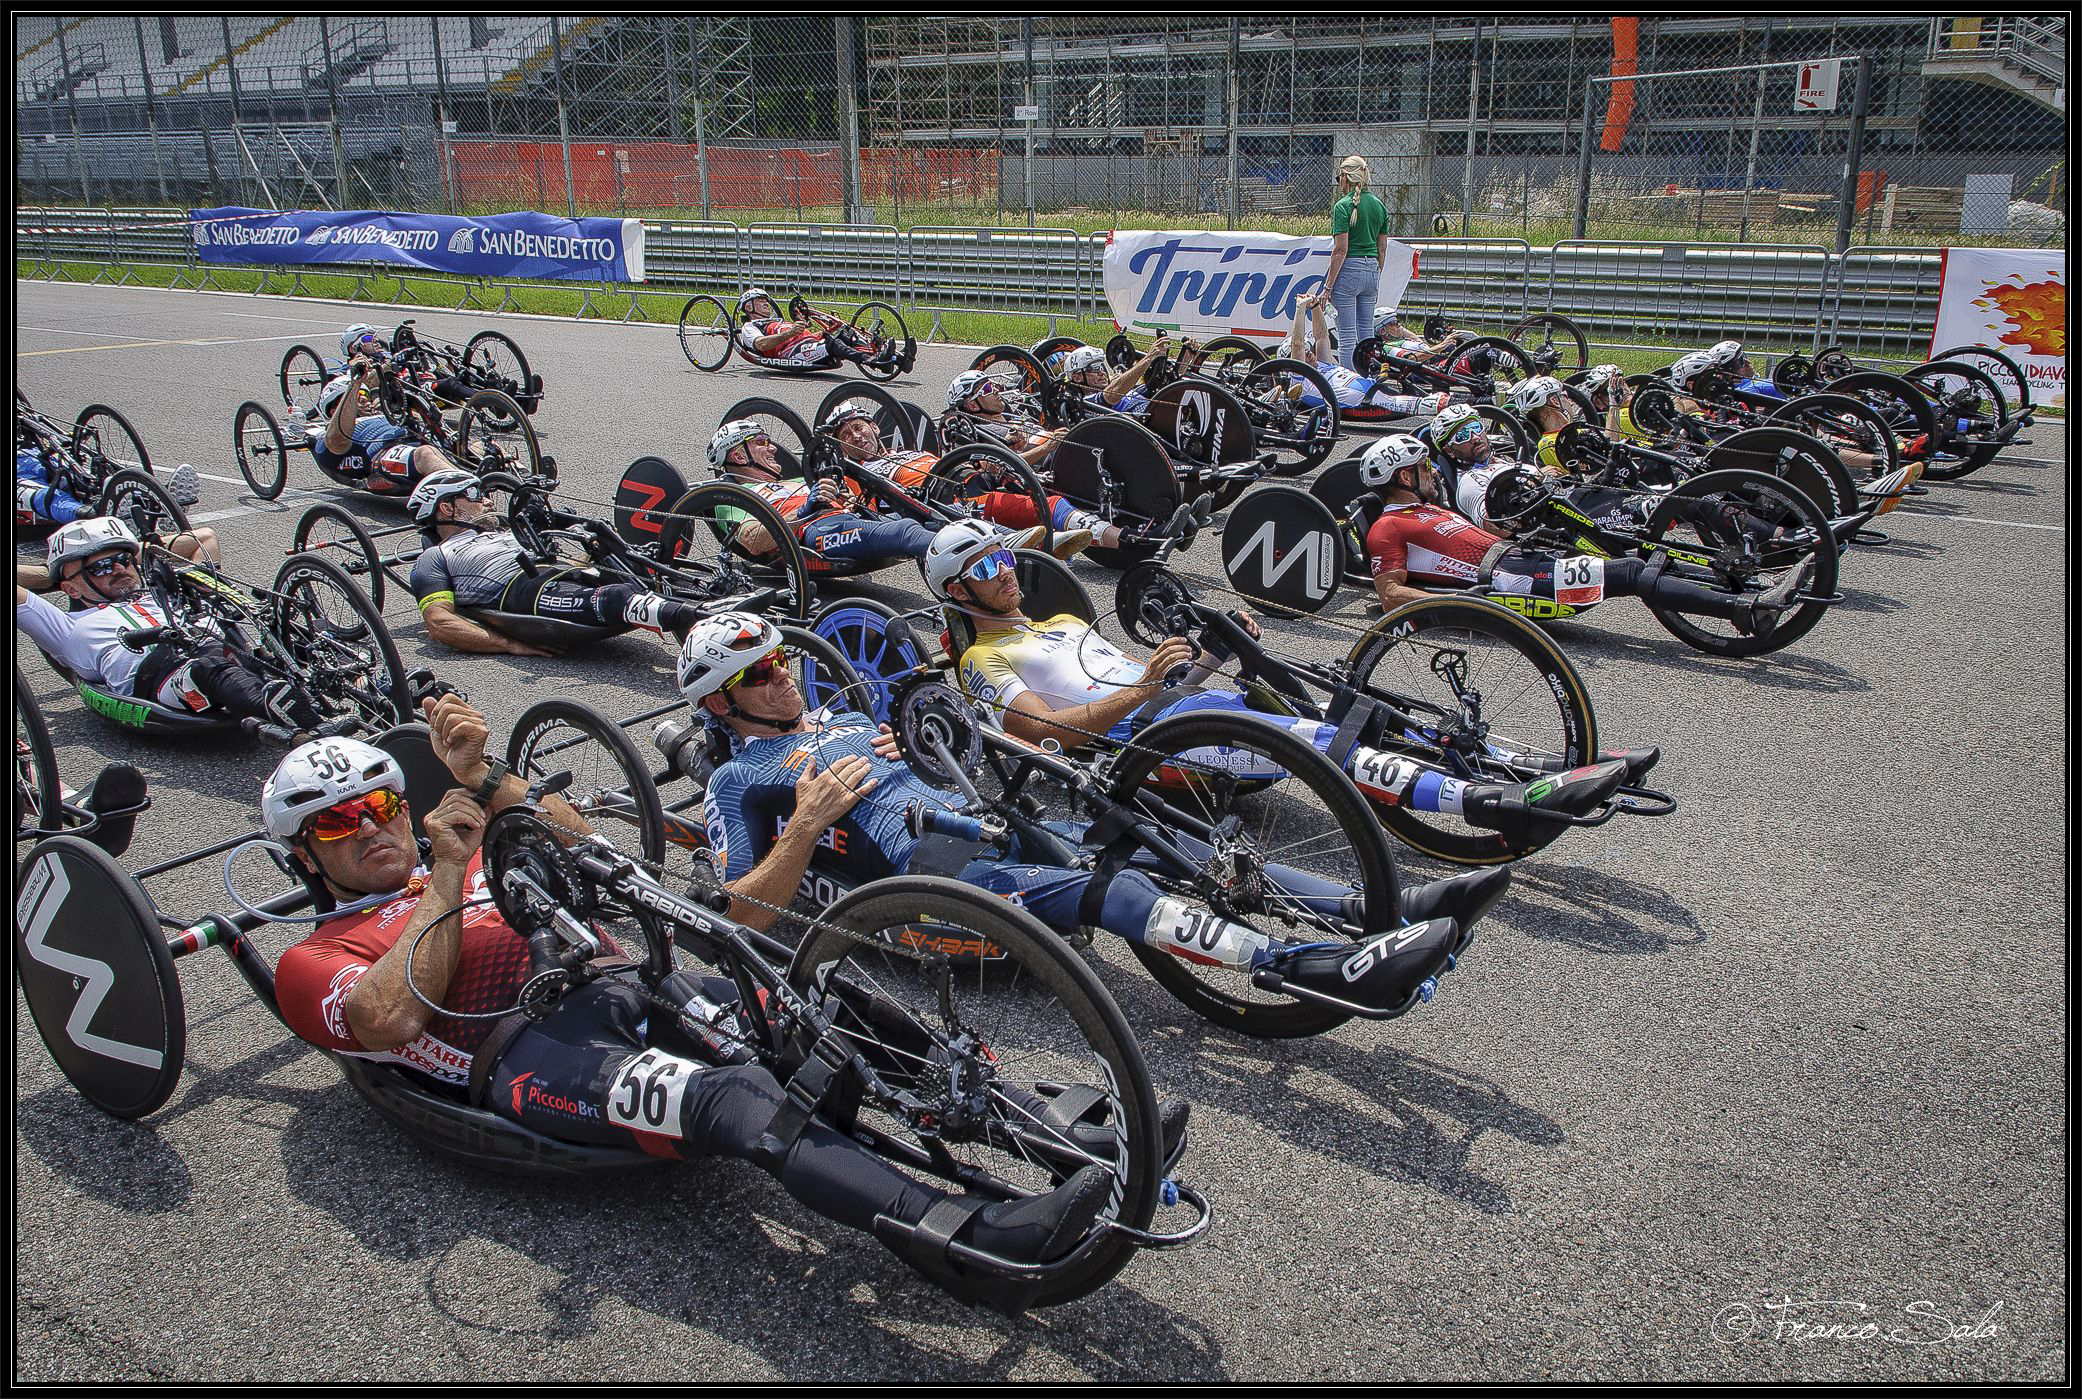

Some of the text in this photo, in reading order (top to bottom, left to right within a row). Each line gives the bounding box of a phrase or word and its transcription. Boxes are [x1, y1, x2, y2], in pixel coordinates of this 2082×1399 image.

[760, 356, 813, 367] CARBIDE
[1974, 379, 2000, 432] CORIM
[1379, 445, 1401, 467] 58
[1865, 420, 1890, 478] CORIM
[416, 485, 437, 504] 48
[1800, 451, 1842, 519] CORIM
[1548, 500, 1596, 528] ARBIDE
[1593, 514, 1633, 525] PARALIMPI
[1610, 508, 1621, 516] GS
[51, 532, 65, 555] 40
[1439, 555, 1479, 574] PITTAR
[1563, 555, 1592, 586] 58
[306, 744, 351, 780] 56
[511, 717, 570, 777] CORIMA
[1197, 754, 1260, 766] LEONESSA
[1361, 753, 1402, 788] 46
[336, 783, 358, 795] KASK
[1441, 775, 1459, 803] ITA
[615, 879, 713, 935] CARBIDE
[1174, 904, 1227, 951] 50
[1342, 919, 1432, 983] GTS
[615, 1062, 679, 1127] 56
[1094, 1050, 1129, 1222] CORIM
